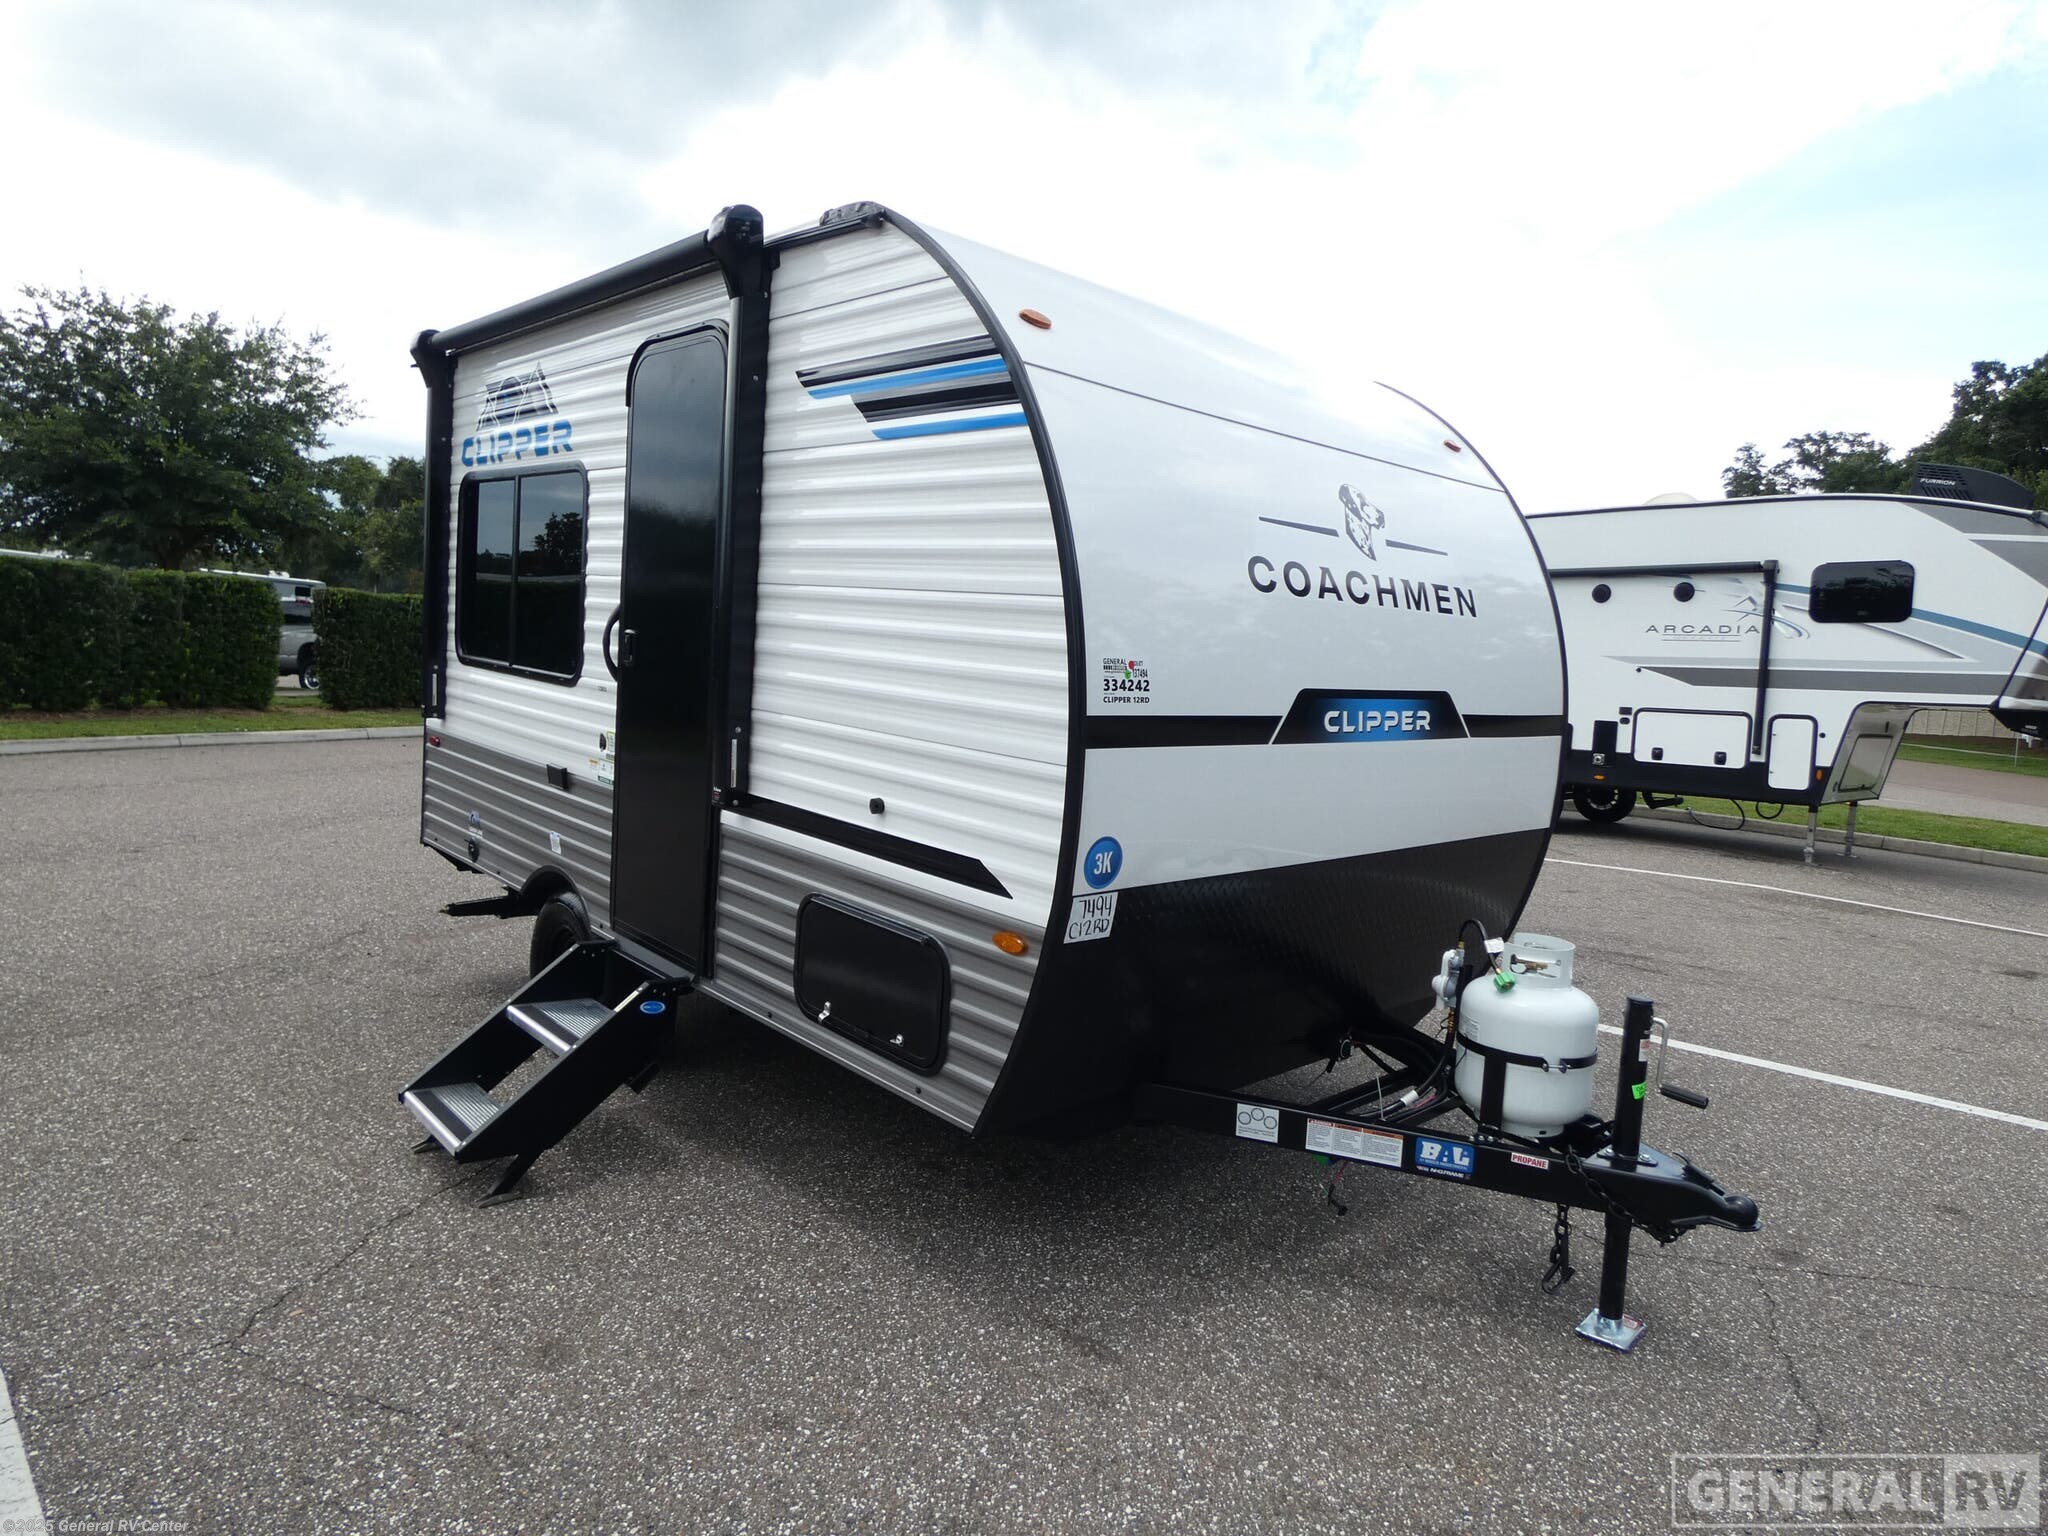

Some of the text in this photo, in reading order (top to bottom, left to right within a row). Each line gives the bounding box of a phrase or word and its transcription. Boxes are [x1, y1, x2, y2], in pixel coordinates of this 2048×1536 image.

[461, 419, 574, 467] CLIPPER
[1247, 555, 1477, 618] COACHMEN
[1645, 624, 1760, 634] ARCADIA
[1103, 678, 1150, 692] 334242
[1103, 696, 1131, 704] CLIPPER
[1323, 710, 1431, 733] CLIPPER
[1093, 851, 1114, 875] 3K
[1079, 894, 1113, 919] 7494
[1512, 1153, 1548, 1169] PROPANE
